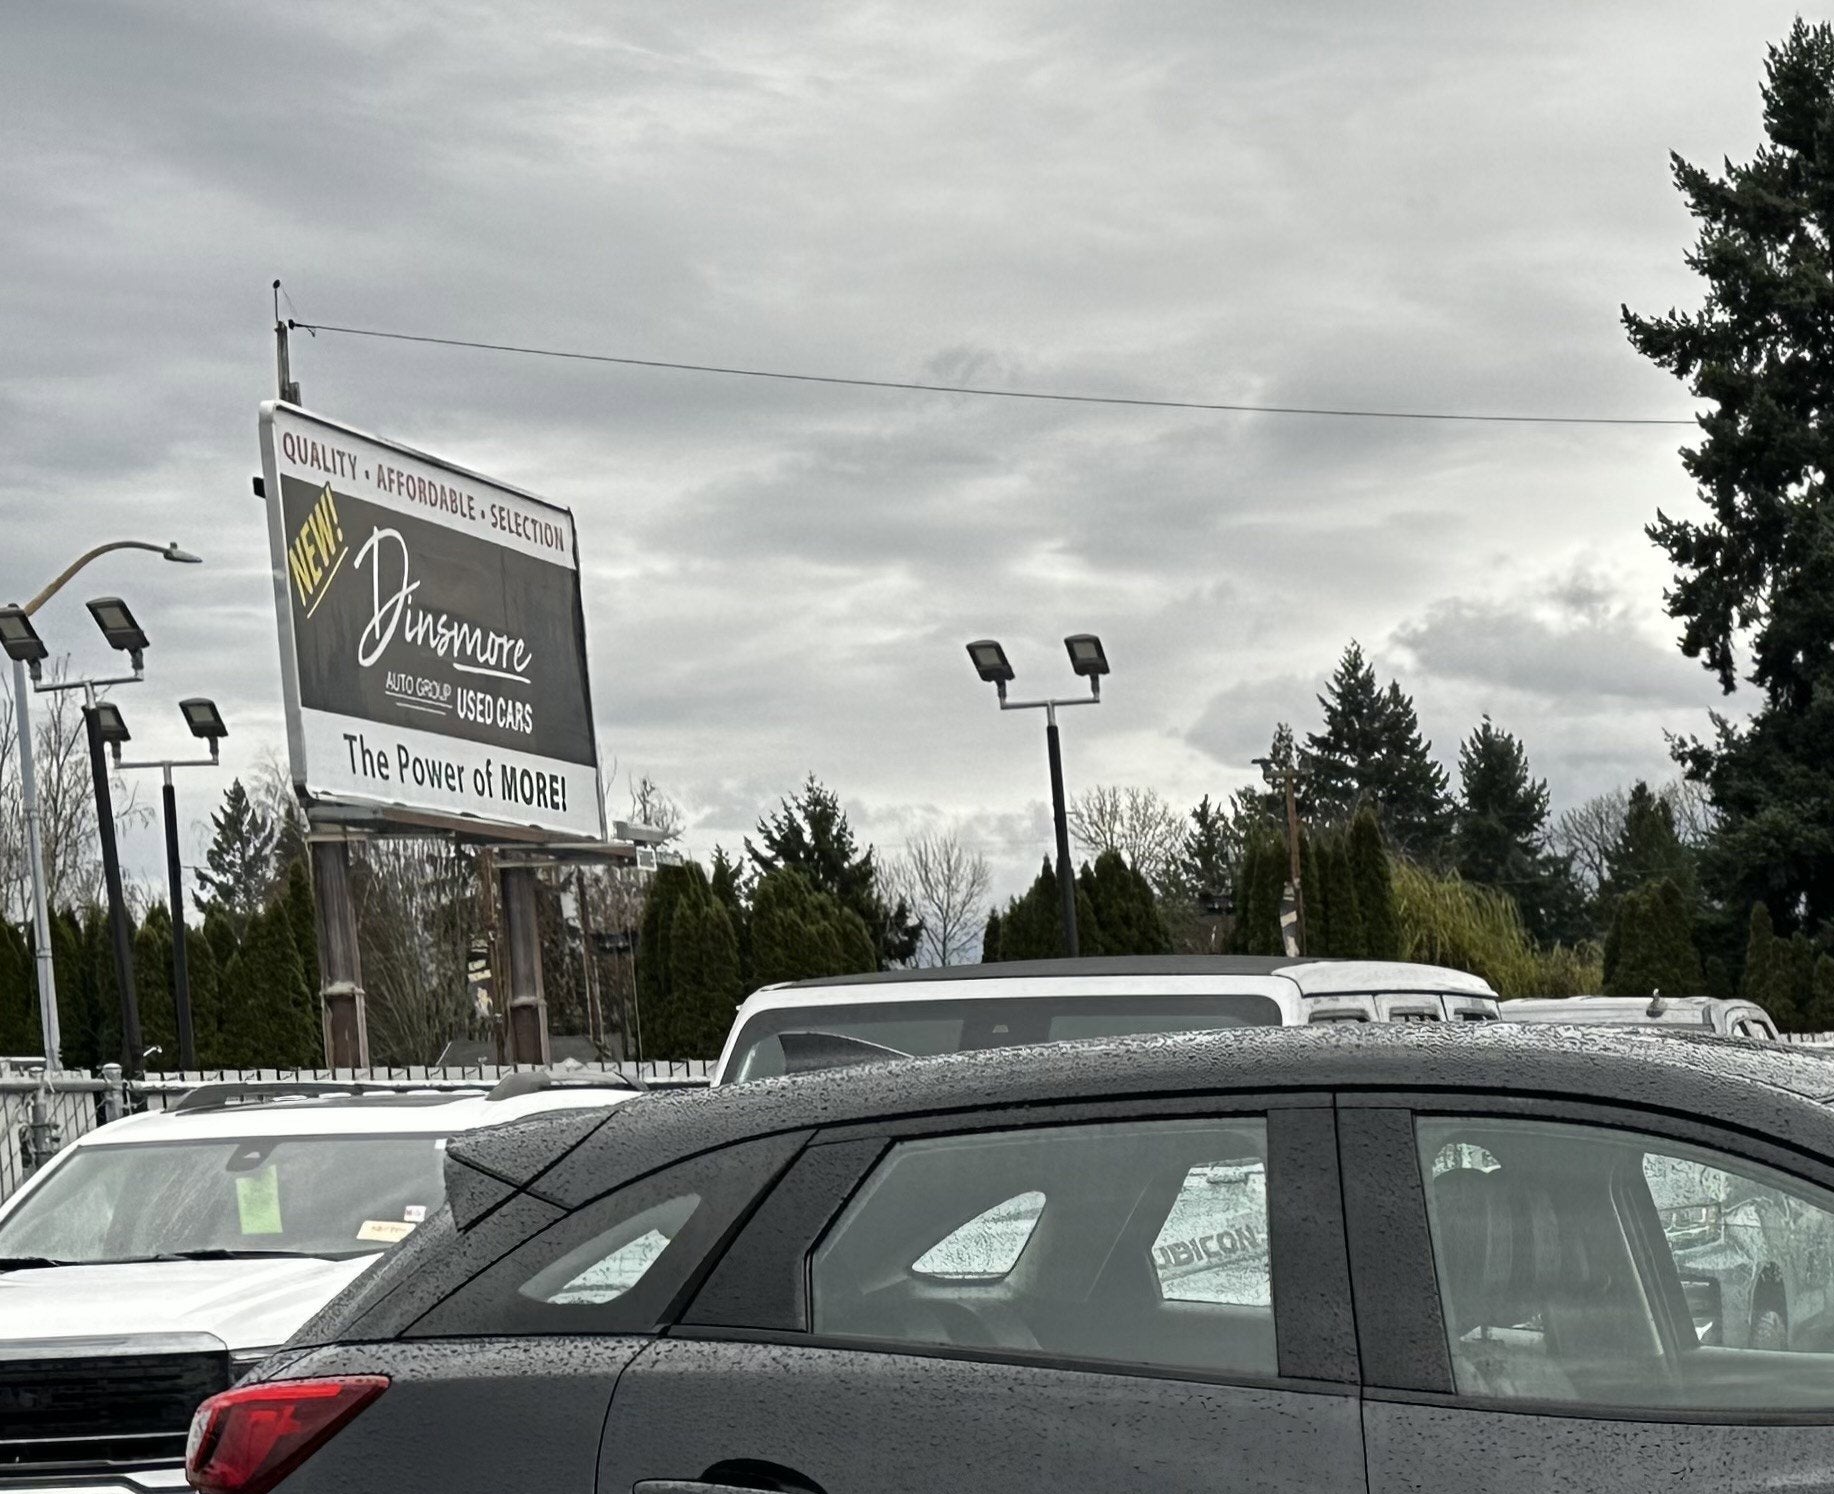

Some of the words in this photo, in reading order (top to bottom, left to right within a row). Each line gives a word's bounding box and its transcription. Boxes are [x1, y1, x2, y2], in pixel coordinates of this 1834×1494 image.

[283, 431, 358, 481] QUALITY
[376, 464, 477, 521] AFFORDABLE
[490, 504, 565, 552] SELECTION
[288, 481, 344, 606] NEW!
[354, 525, 533, 674] Dinsmore
[385, 671, 413, 694] AUTO
[416, 677, 452, 701] GROUP
[457, 687, 494, 725] USED
[497, 696, 533, 734] CARS
[343, 733, 390, 782] The
[397, 743, 464, 794] Power
[474, 758, 494, 798] of
[501, 763, 567, 812] MORE!
[1155, 1224, 1261, 1269] UBICON
